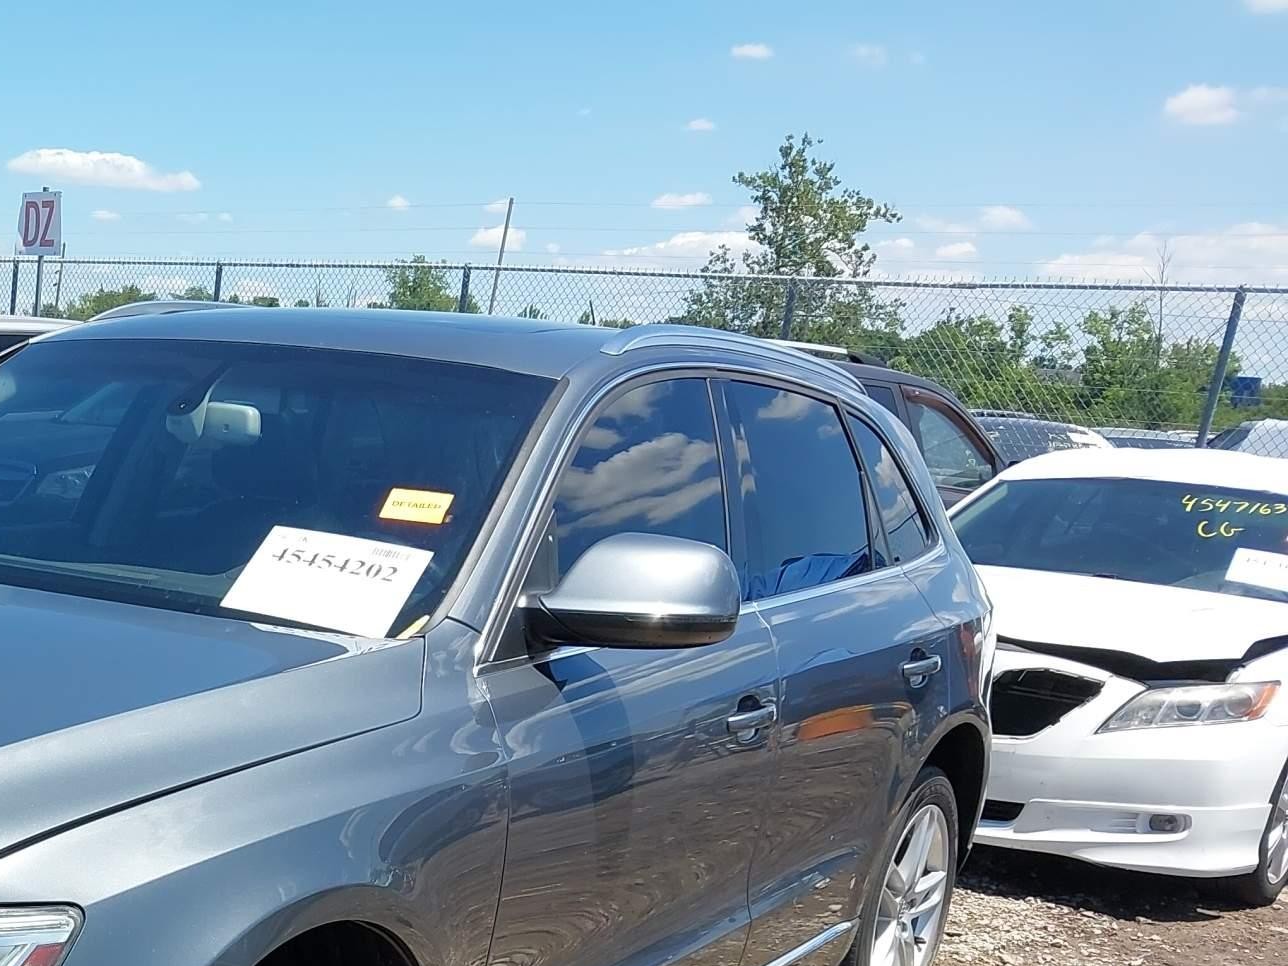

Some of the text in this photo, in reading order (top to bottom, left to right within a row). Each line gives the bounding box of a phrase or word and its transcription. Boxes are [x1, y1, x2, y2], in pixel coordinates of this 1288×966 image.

[23, 200, 55, 247] DZ
[1181, 494, 1288, 515] 4547163
[1197, 520, 1246, 537] CG
[271, 547, 398, 582] 45454202
